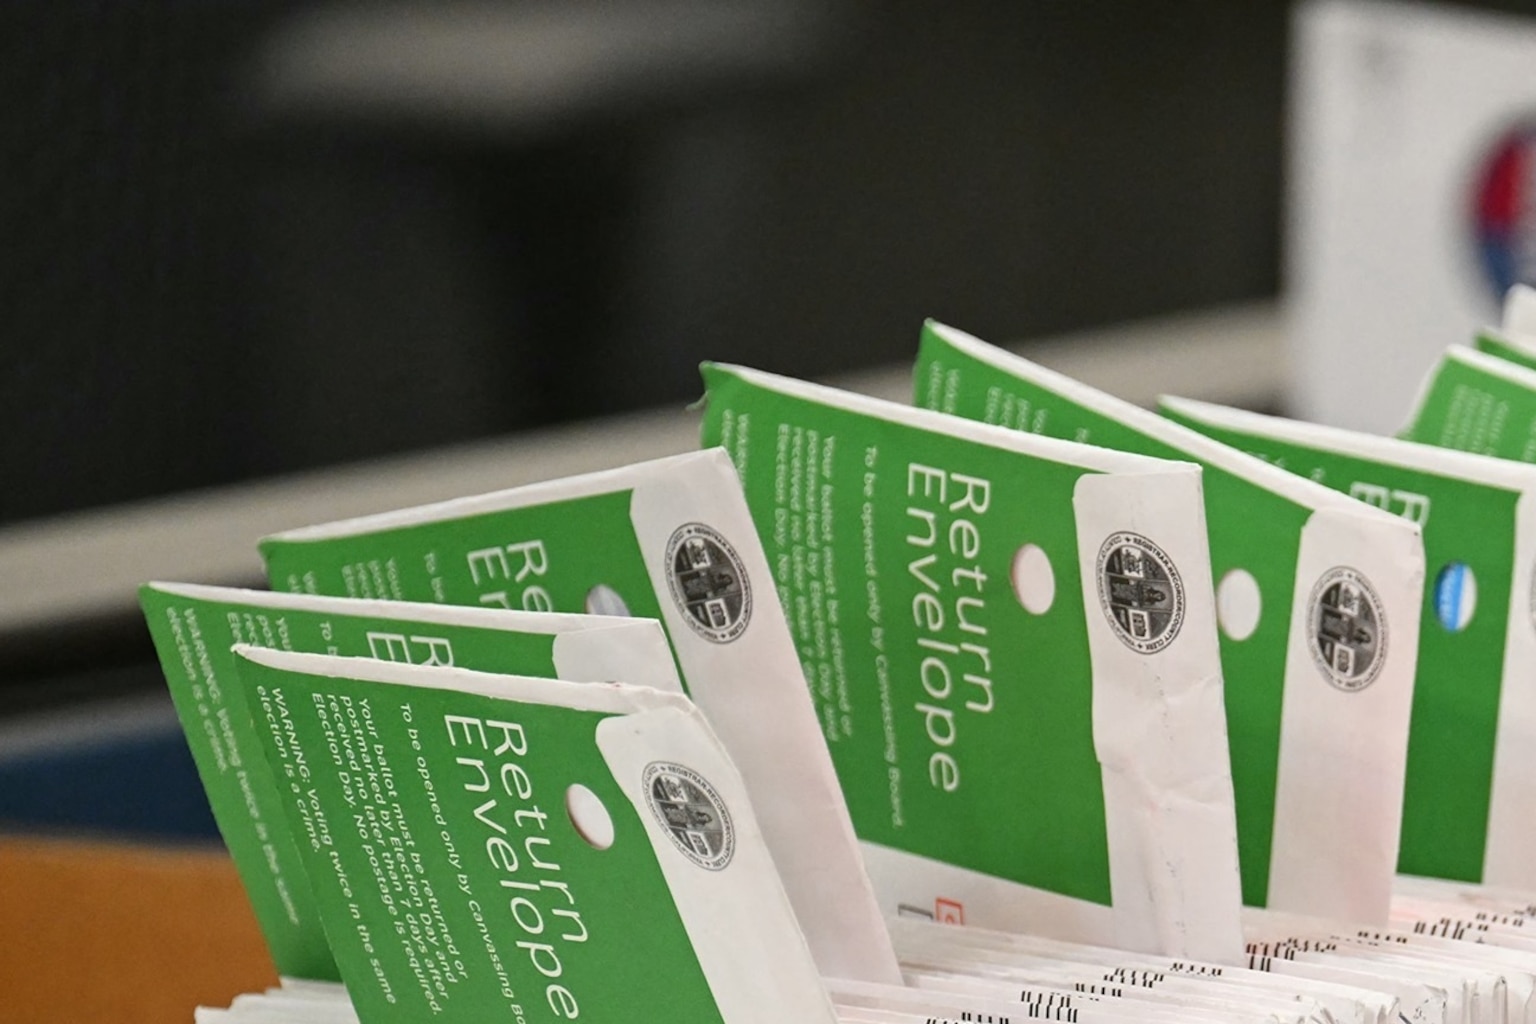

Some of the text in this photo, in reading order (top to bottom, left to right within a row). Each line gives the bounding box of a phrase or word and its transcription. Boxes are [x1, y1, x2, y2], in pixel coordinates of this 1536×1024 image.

[906, 461, 960, 792] Envelope
[948, 470, 995, 714] Return
[257, 685, 319, 852] election crime.
[271, 687, 394, 1002] WARNING: Voting twice the same
[312, 692, 342, 765] Election
[338, 771, 356, 808] Day.
[361, 844, 396, 915] postage
[401, 939, 441, 1014] required.
[326, 694, 448, 998] received later than days after
[339, 695, 457, 982] postmarked by Election Day and
[358, 698, 459, 954] Your ballot must be returned
[400, 703, 412, 722] To
[407, 728, 420, 750] be
[416, 756, 446, 825] opened
[440, 830, 461, 868] only
[457, 873, 472, 894] by
[468, 900, 514, 998] Canvassing
[443, 714, 580, 1020] Envelope
[484, 718, 589, 943] Return
